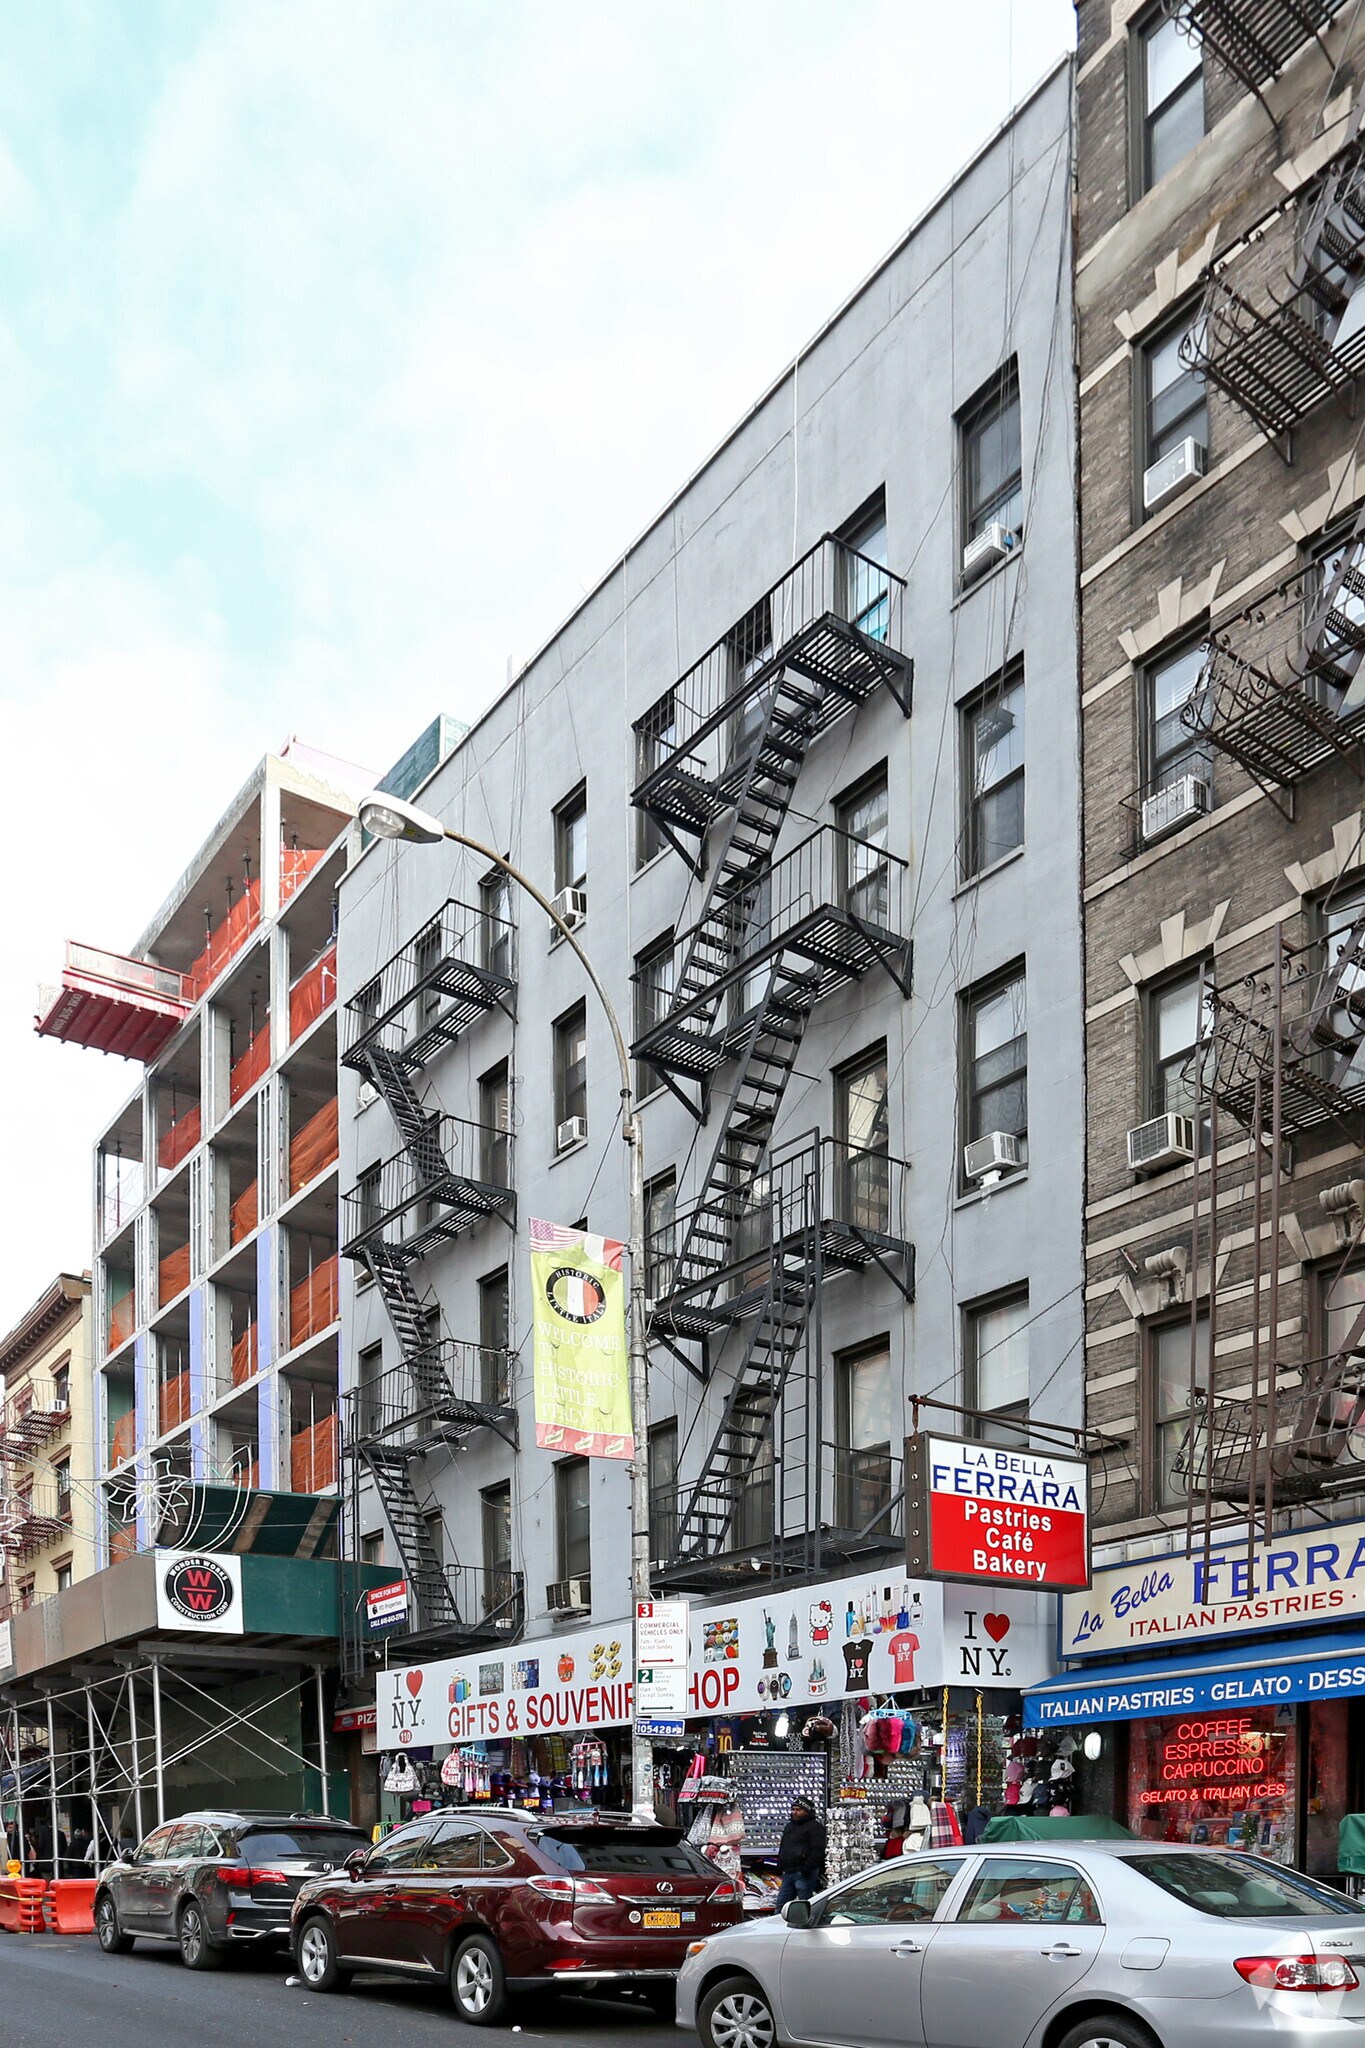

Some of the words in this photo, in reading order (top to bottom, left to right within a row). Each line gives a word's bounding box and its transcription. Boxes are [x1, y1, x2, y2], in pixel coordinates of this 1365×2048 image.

[555, 1268, 600, 1289] HISTORIC
[546, 1291, 579, 1323] LITTLE
[583, 1302, 606, 1324] ITALY
[537, 1321, 621, 1351] WELCOME
[539, 1342, 557, 1359] TO
[540, 1360, 619, 1389] HISTORIC
[540, 1382, 597, 1407] LITTLE
[542, 1402, 589, 1425] ITALY
[962, 1447, 989, 1468] LA
[995, 1452, 1055, 1479] BELLA
[932, 1464, 1081, 1511] FERRARA
[964, 1500, 1052, 1532] Pastries
[986, 1527, 1034, 1553] Café
[169, 1559, 201, 1577] WONDER
[203, 1559, 229, 1581] WORKS
[973, 1549, 1047, 1582] Bakery
[186, 1569, 212, 1587] W
[170, 1597, 216, 1620] CONSTRUCTION
[215, 1601, 229, 1615] CORP
[187, 1592, 213, 1610] W
[641, 1604, 650, 1617] 3
[1072, 1609, 1105, 1646] La
[1111, 1570, 1175, 1619] Bella
[964, 1611, 977, 1639] I
[1130, 1609, 1216, 1638] ITALIAN
[1222, 1589, 1344, 1623] PASTRIES
[897, 1652, 911, 1662] NY
[898, 1643, 903, 1652] I
[849, 1668, 864, 1678] NY
[850, 1659, 855, 1669] I
[393, 1673, 402, 1700] I
[641, 1669, 650, 1683] 2
[1040, 1696, 1104, 1719] ITALIAN
[1107, 1687, 1195, 1712] PASTRIES
[1210, 1675, 1292, 1701] GELATO
[448, 1701, 500, 1738] GIFTS
[506, 1698, 519, 1732] &
[1278, 1703, 1293, 1718] A
[399, 1731, 412, 1742] 110
[1177, 1718, 1252, 1741] COFFEE
[717, 1735, 732, 1753] 10
[1165, 1737, 1264, 1760] ESPRESSO
[1163, 1757, 1264, 1780] CAPPUCCINO
[1140, 1789, 1187, 1804] GELATO
[1190, 1787, 1199, 1800] &
[1203, 1786, 1251, 1800] ITALIAN
[1253, 1784, 1287, 1797] ICES
